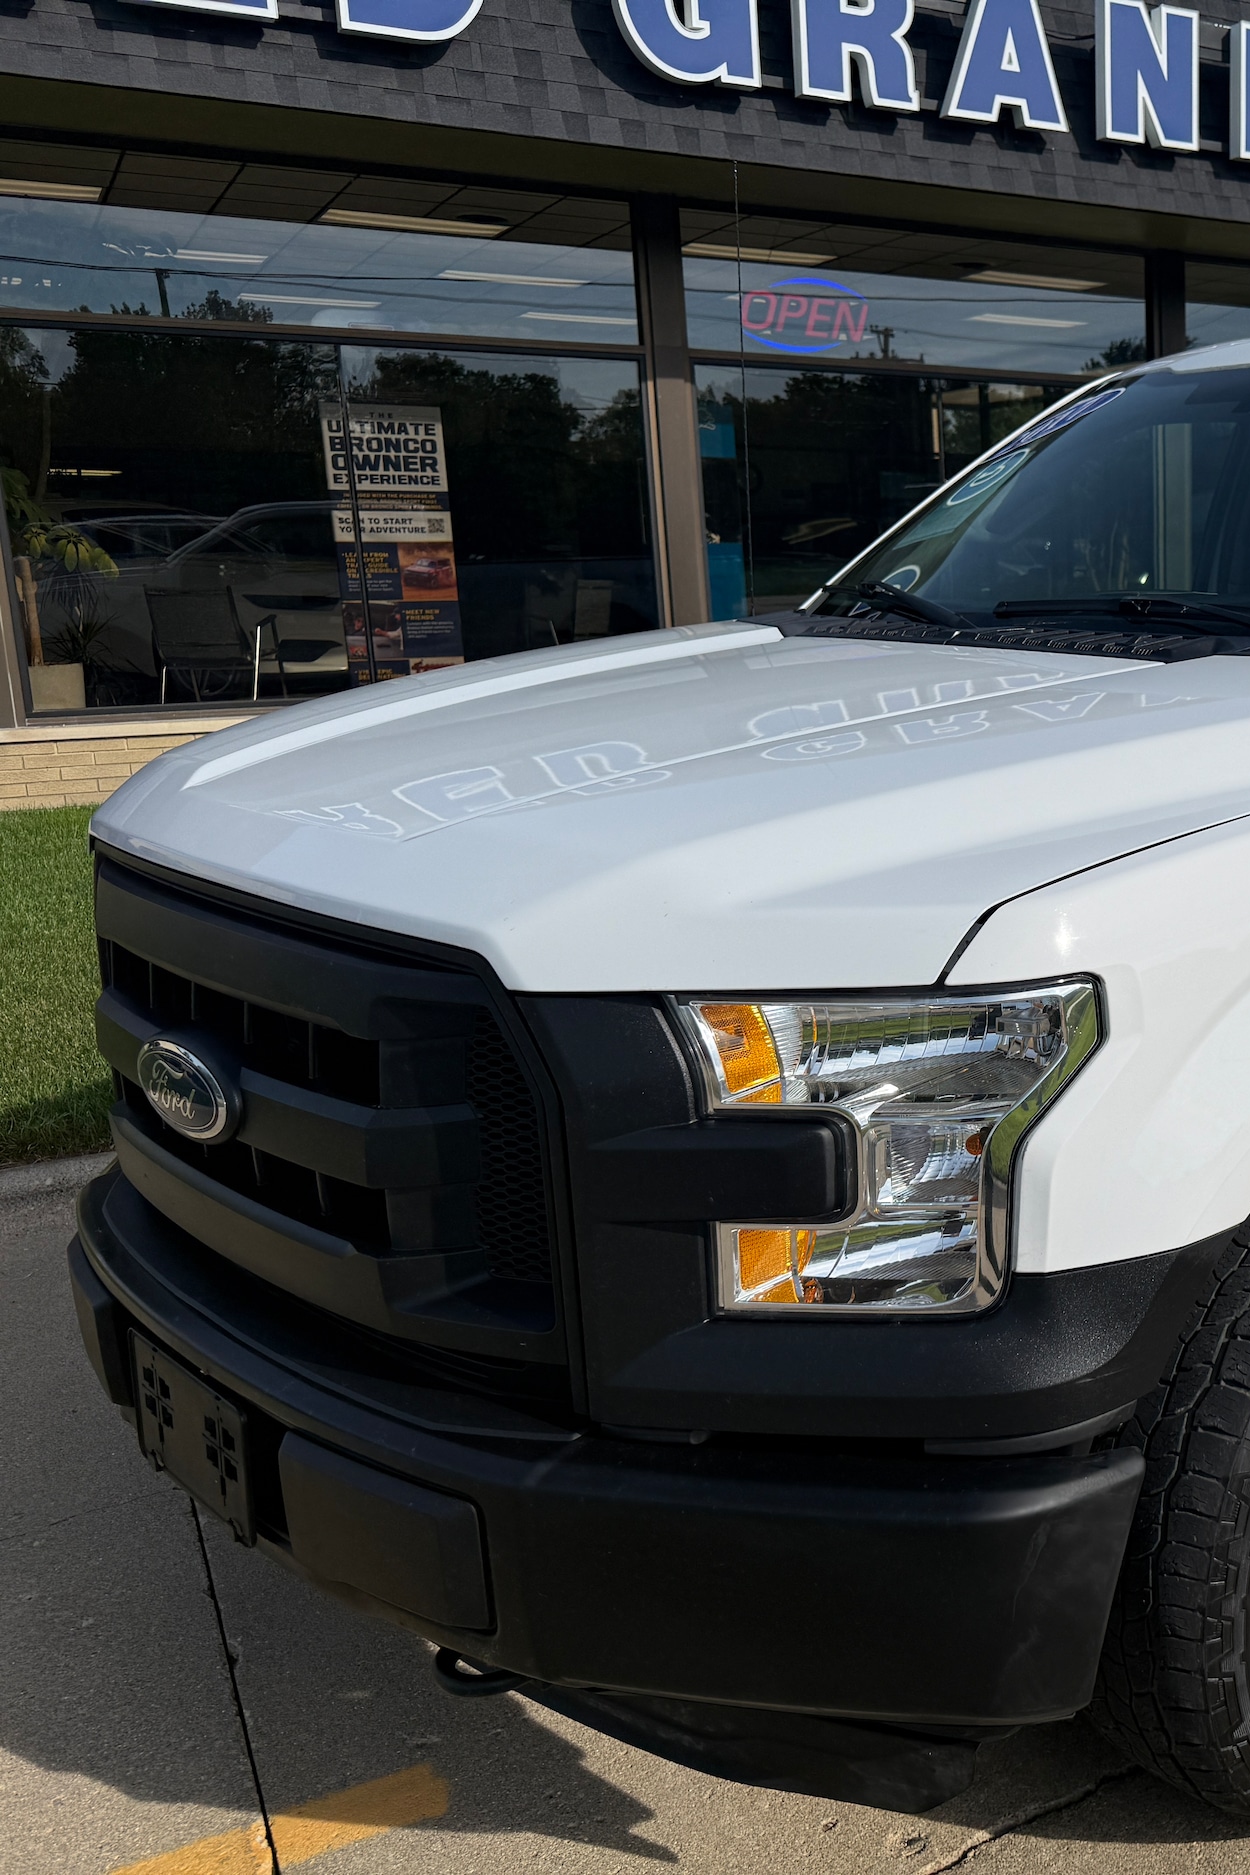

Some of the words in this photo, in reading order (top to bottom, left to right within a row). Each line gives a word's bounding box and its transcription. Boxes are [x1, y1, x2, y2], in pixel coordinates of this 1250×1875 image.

[741, 289, 869, 342] OPEN
[369, 411, 393, 419] THE
[327, 419, 436, 436] UTIMATE
[329, 436, 437, 454] BRONCO
[331, 453, 439, 473] OWNER
[338, 517, 364, 525] SCN
[367, 517, 380, 525] TO
[369, 526, 427, 534] ADVENTURE
[149, 1059, 196, 1120] Ford
